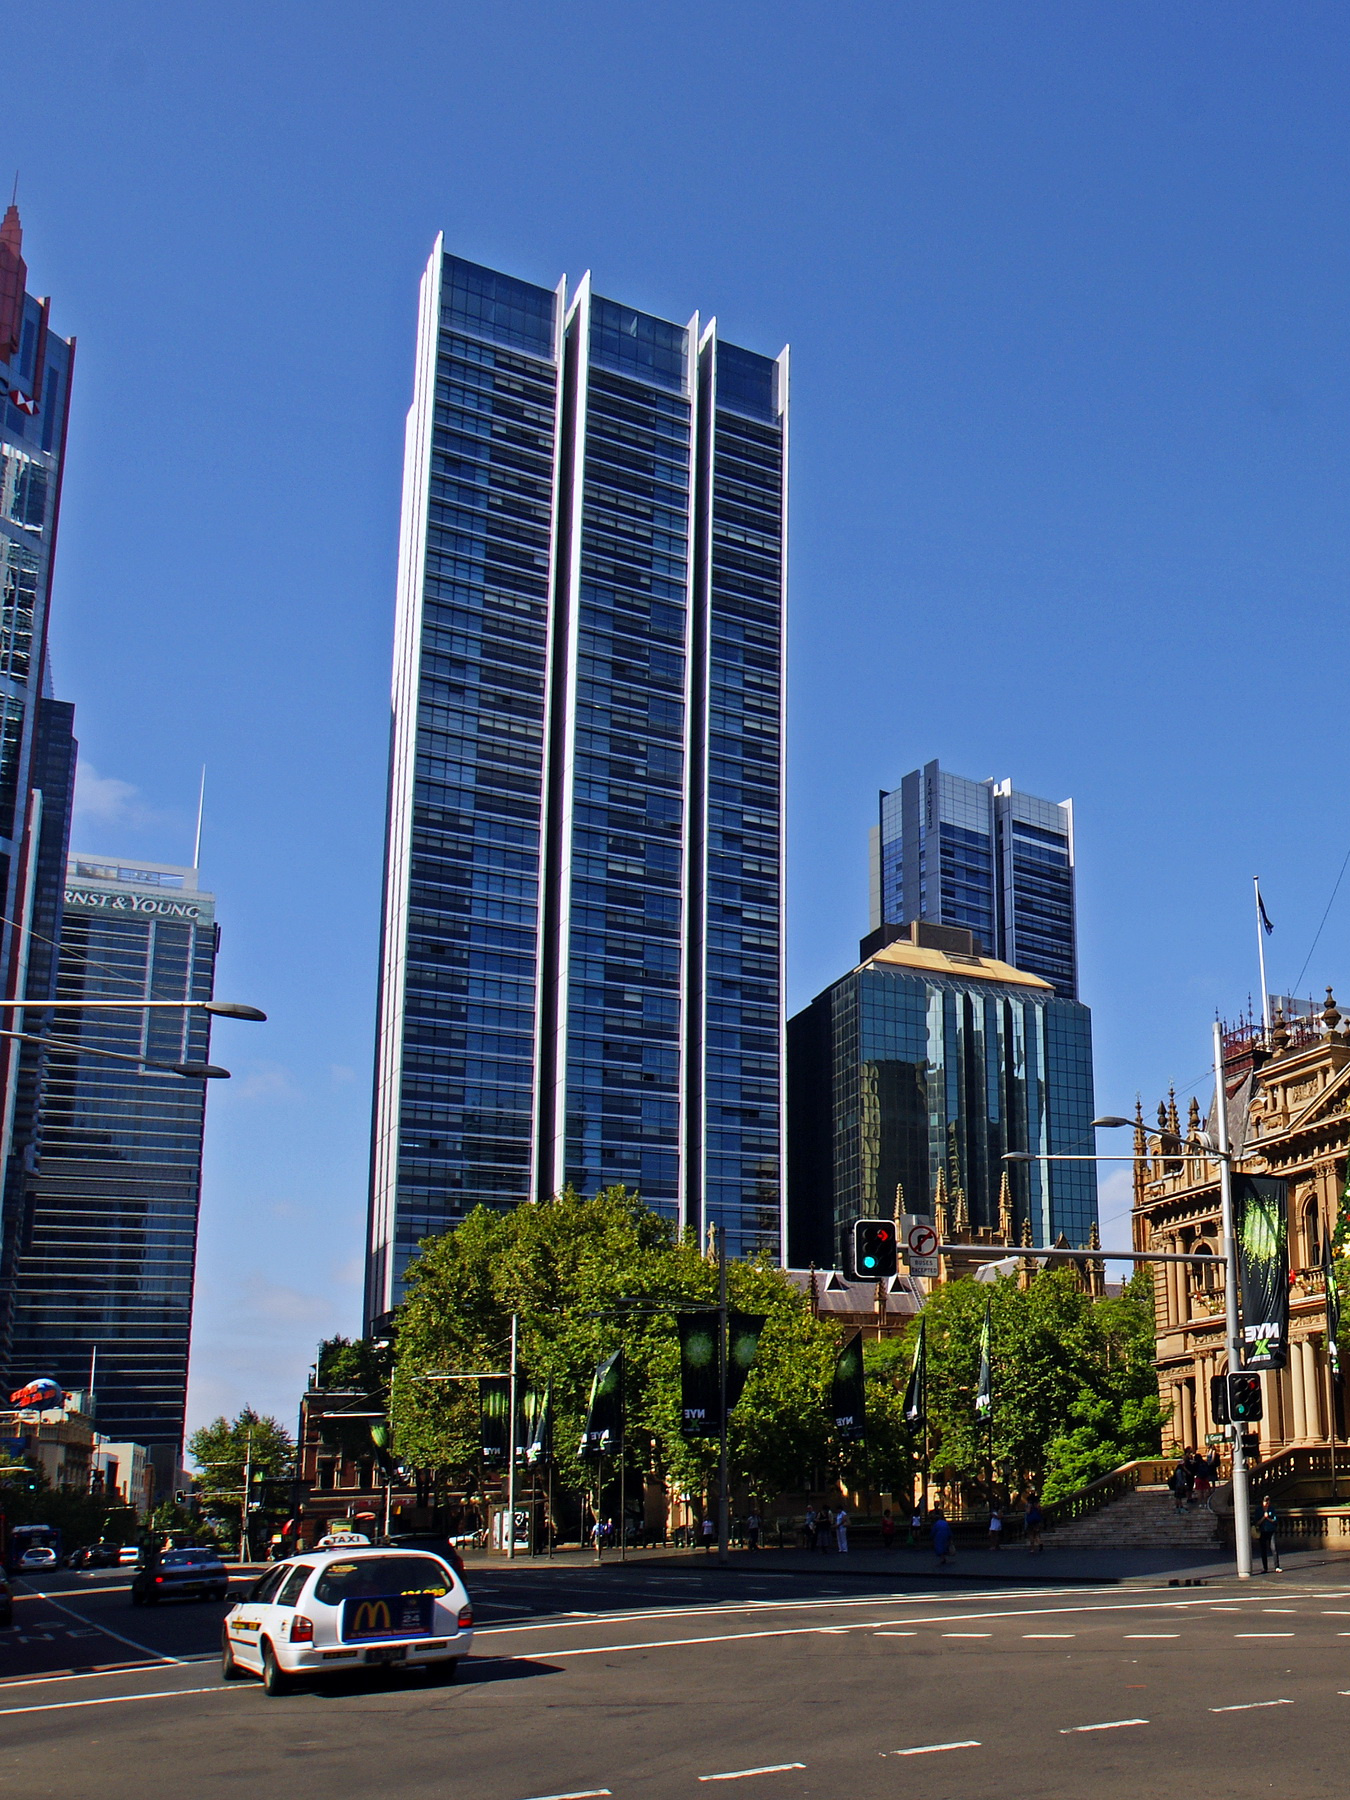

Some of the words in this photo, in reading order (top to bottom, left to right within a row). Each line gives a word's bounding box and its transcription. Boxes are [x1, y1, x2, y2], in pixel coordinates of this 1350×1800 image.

[64, 890, 112, 907] RNST
[112, 896, 127, 910] &
[331, 1535, 360, 1543] TAXI
